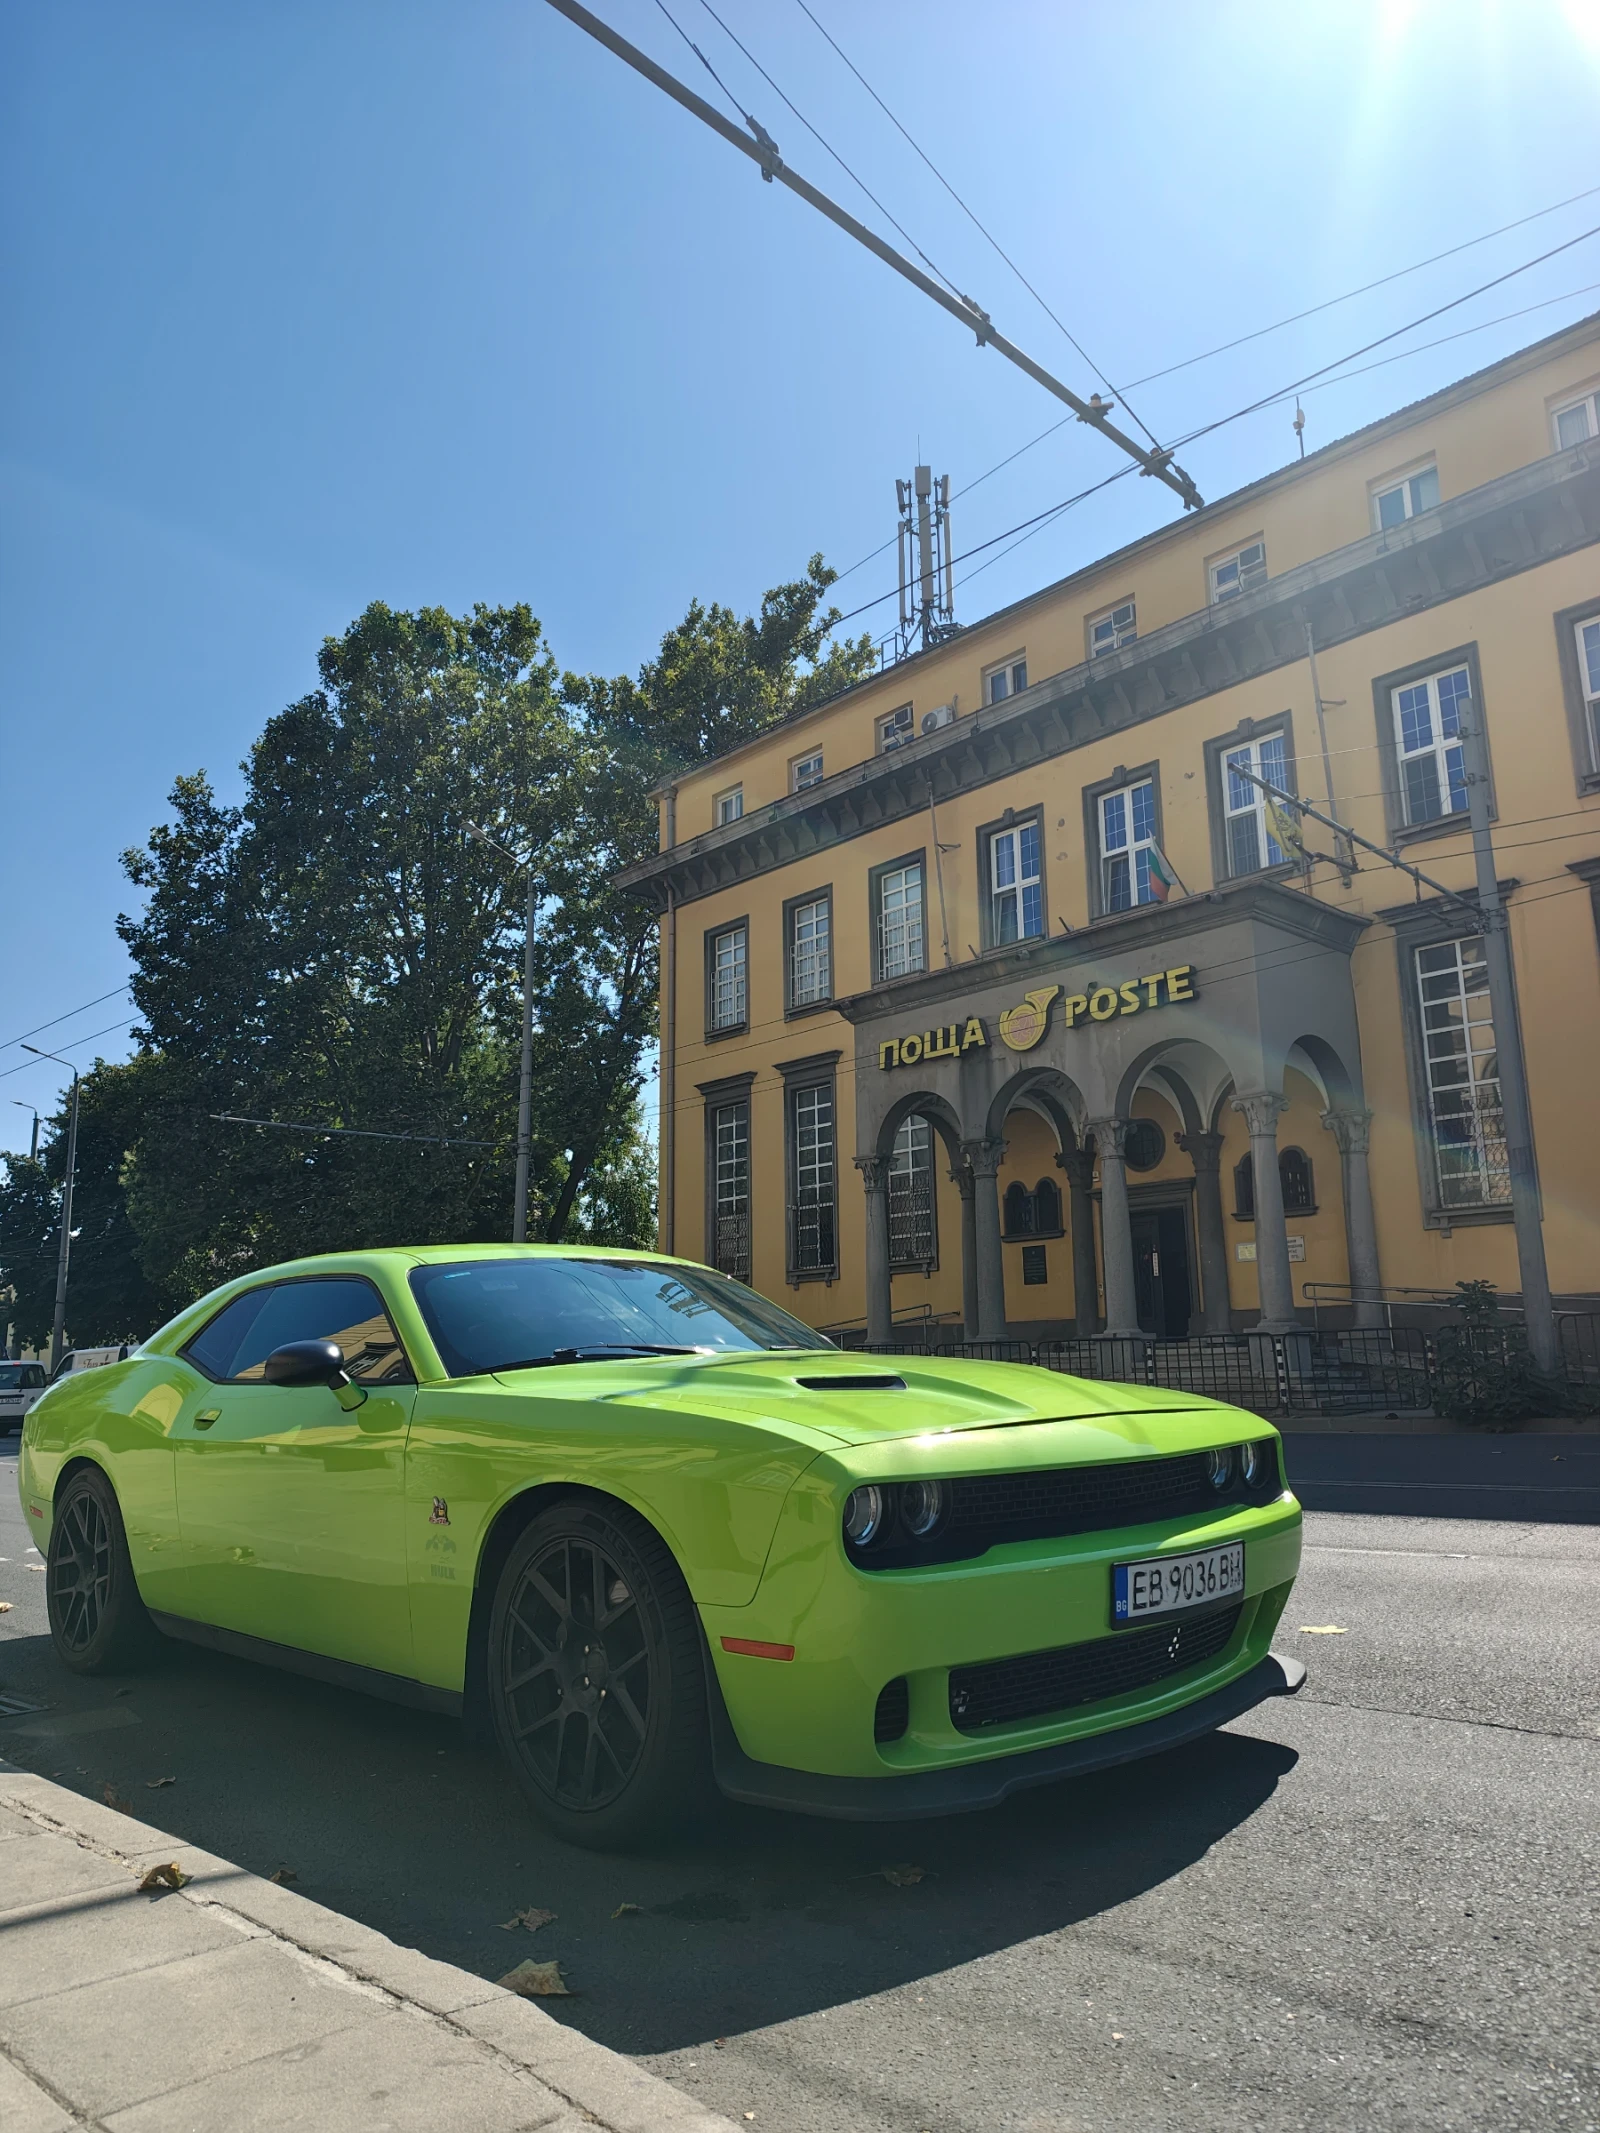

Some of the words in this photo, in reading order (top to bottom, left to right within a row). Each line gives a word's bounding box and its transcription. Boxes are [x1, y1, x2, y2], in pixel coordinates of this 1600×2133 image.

[1066, 965, 1196, 1028] POSTE
[879, 1018, 988, 1071] ПОЩА
[601, 1525, 653, 1604] NEXEN
[1116, 1600, 1127, 1613] BG
